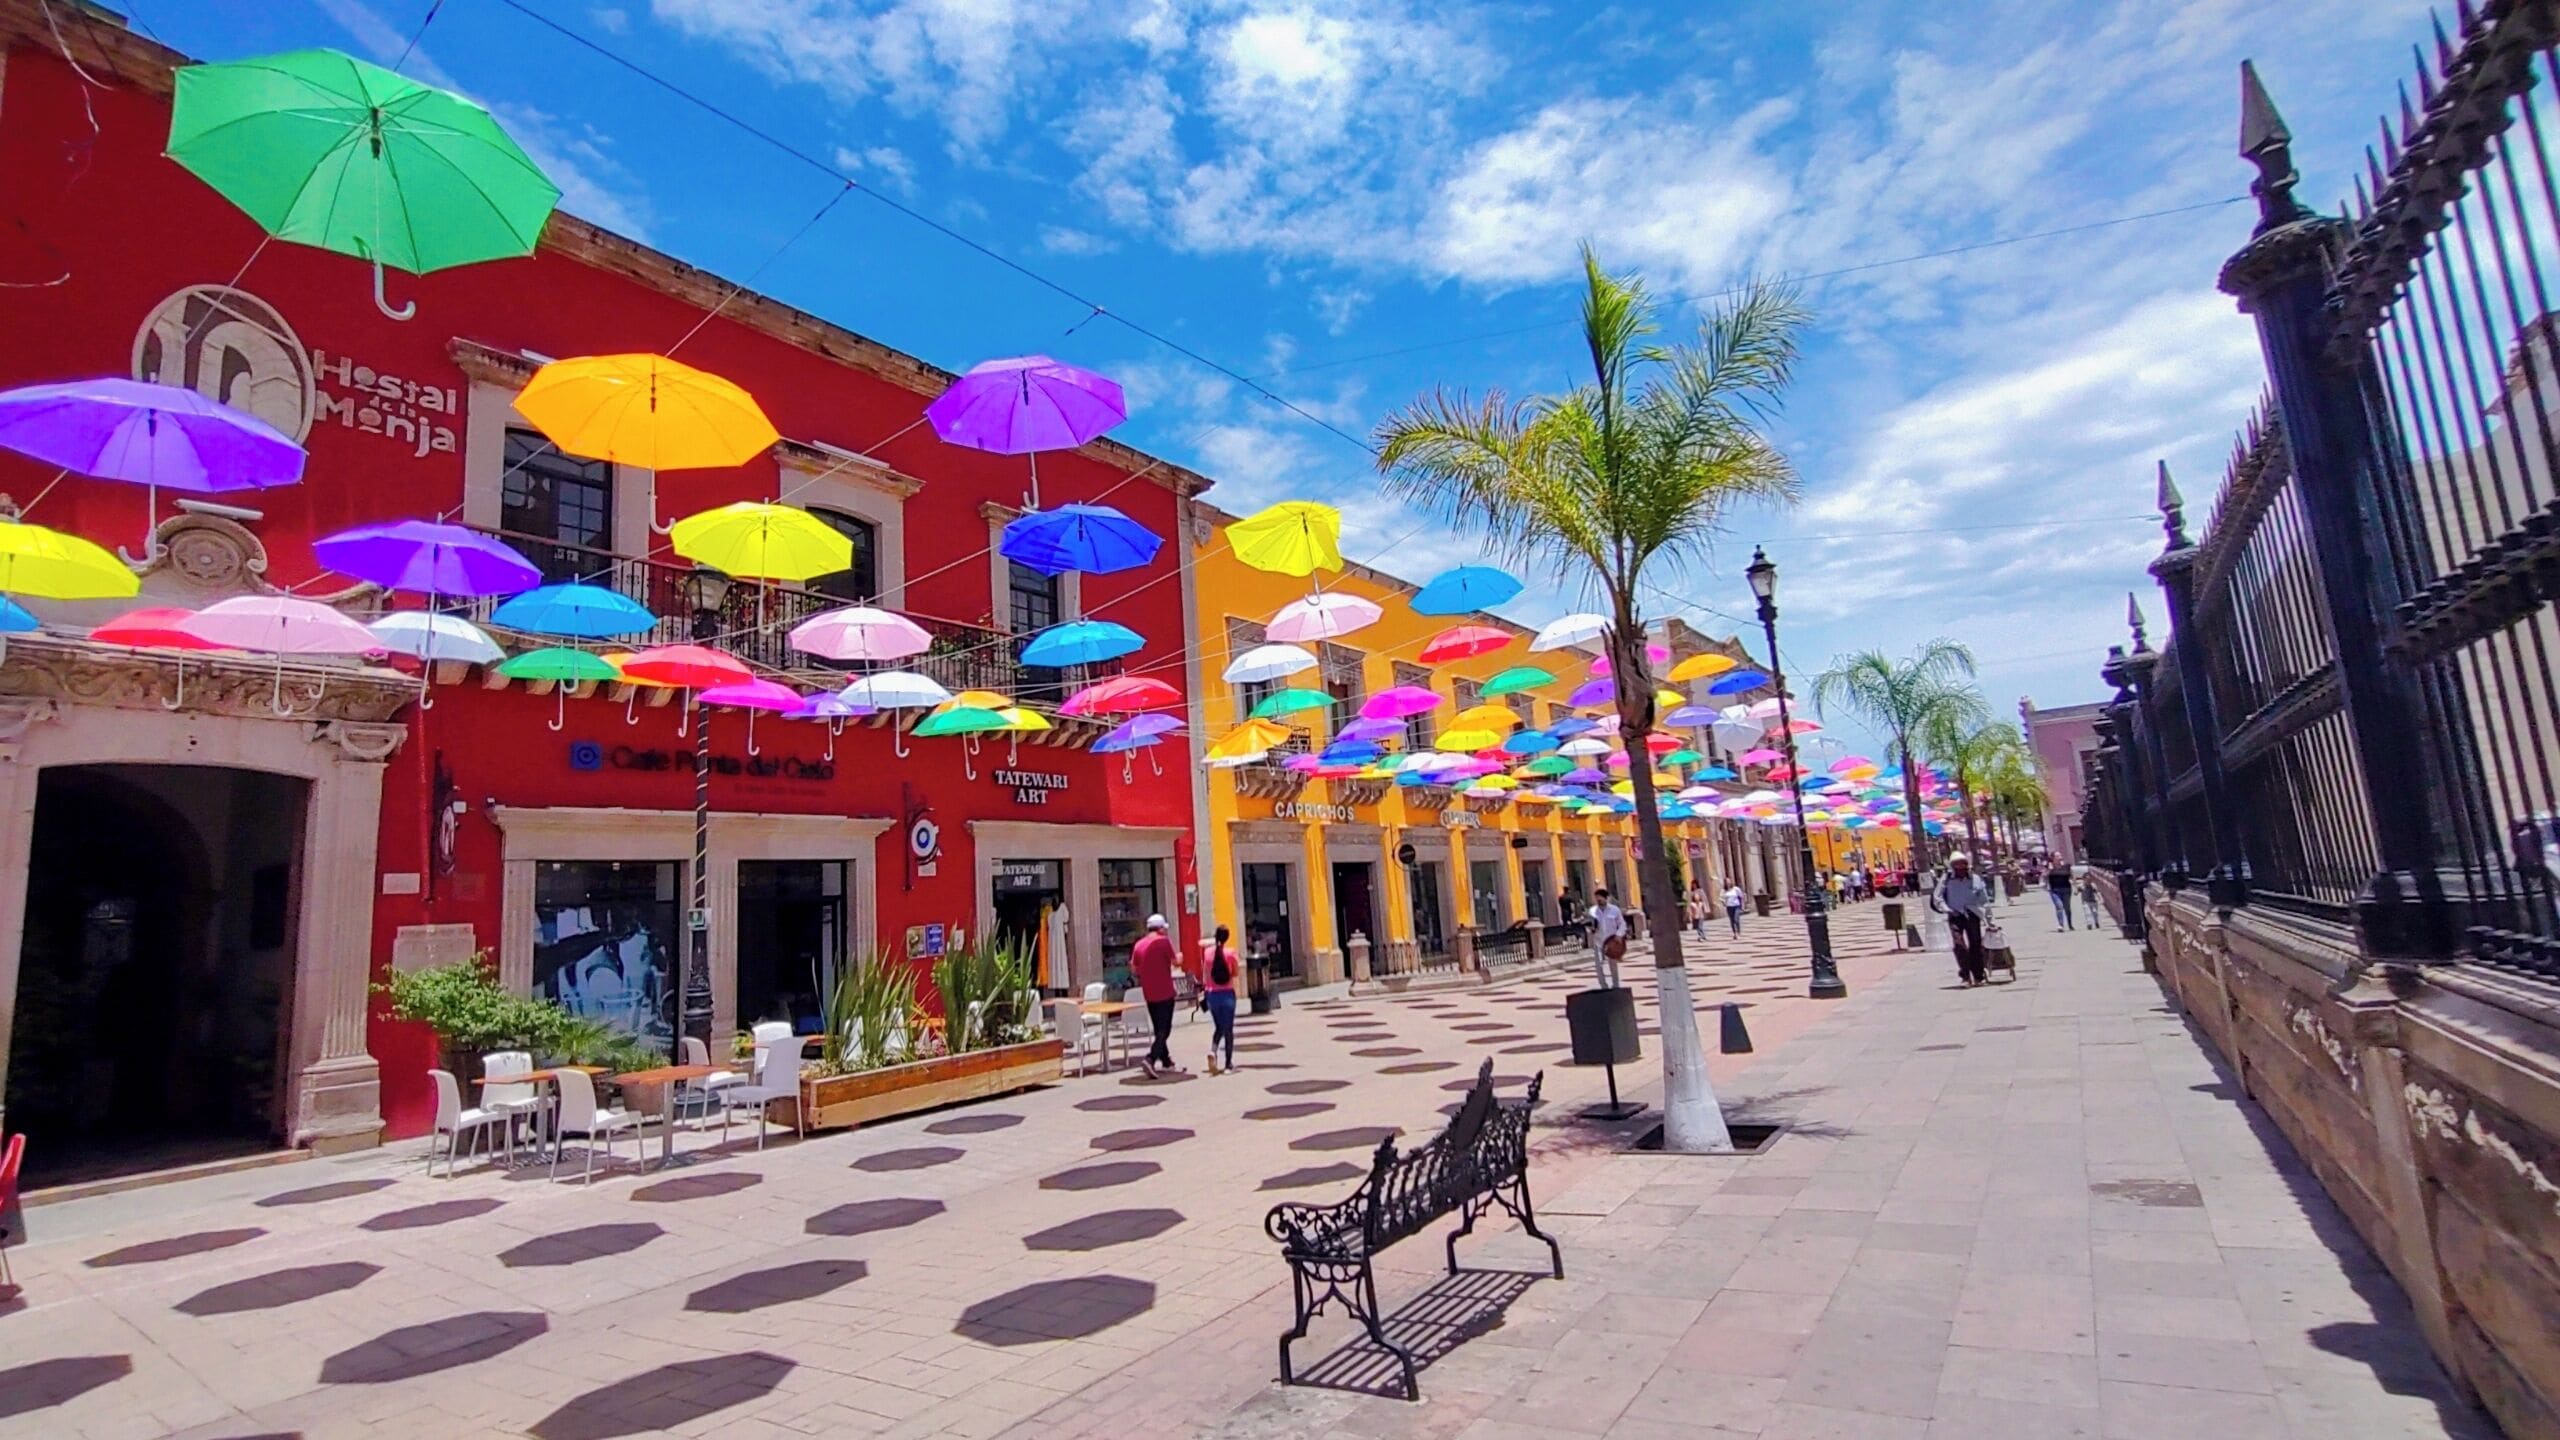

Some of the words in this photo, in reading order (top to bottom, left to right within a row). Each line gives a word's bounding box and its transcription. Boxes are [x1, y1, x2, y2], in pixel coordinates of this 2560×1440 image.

[313, 349, 456, 415] Hostal
[314, 390, 456, 458] Monja
[674, 750, 742, 775] Pnta
[995, 770, 1068, 788] TATEWARI
[1017, 788, 1048, 803] ART
[1275, 801, 1354, 821] CAPRICHOS
[1013, 875, 1032, 886] ART
